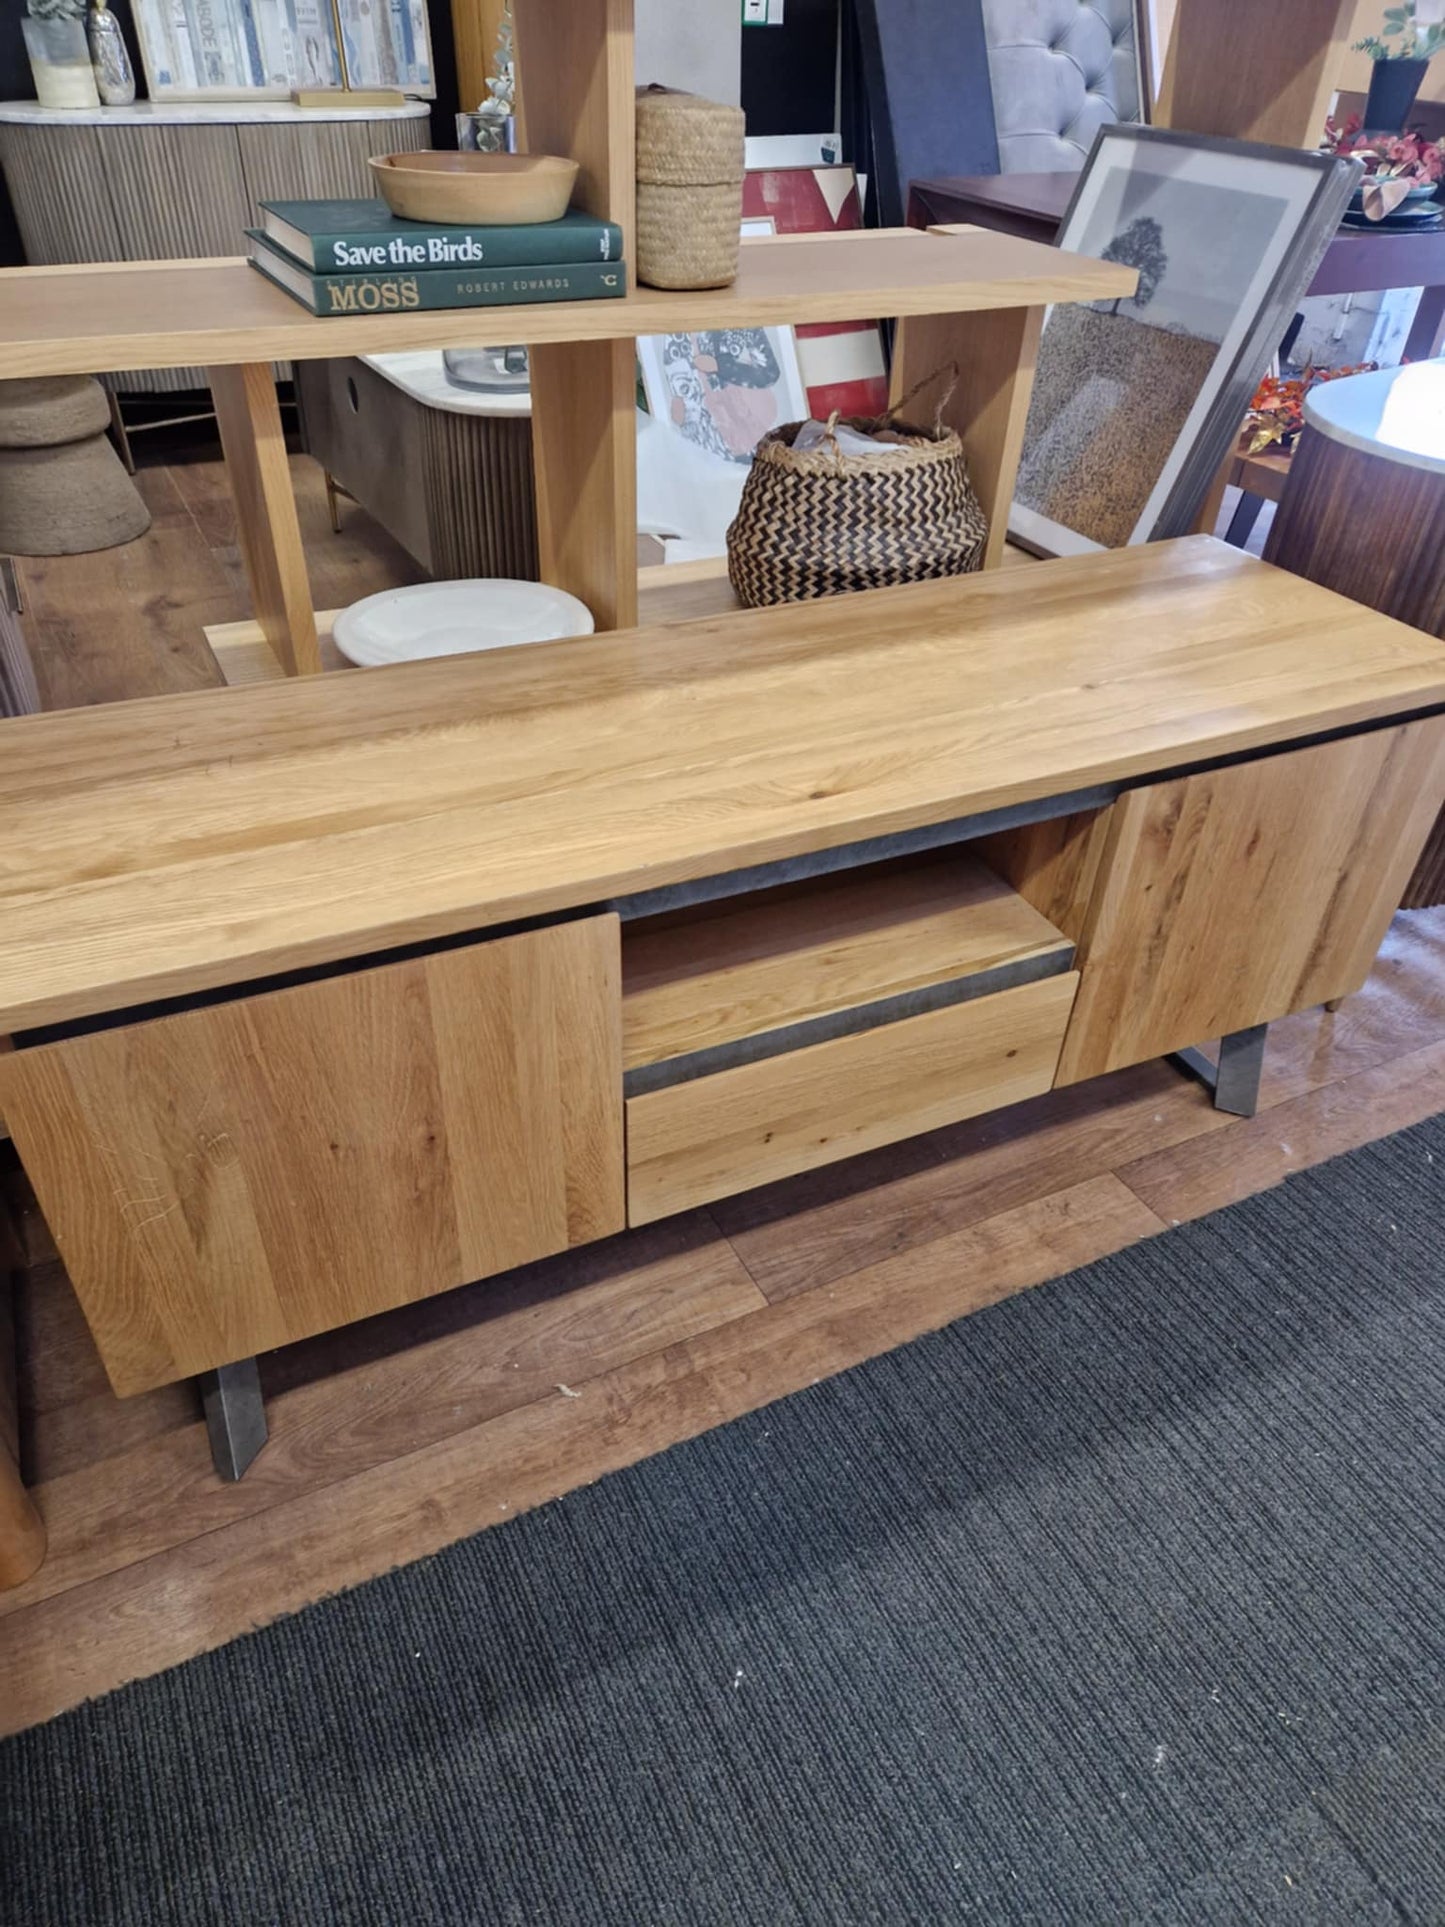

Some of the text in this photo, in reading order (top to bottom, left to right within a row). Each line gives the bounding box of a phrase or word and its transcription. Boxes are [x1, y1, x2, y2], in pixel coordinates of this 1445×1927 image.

[333, 235, 484, 266] Save the Birds
[327, 281, 420, 311] MOSS
[456, 278, 570, 295] ROBERT EDWARDS
